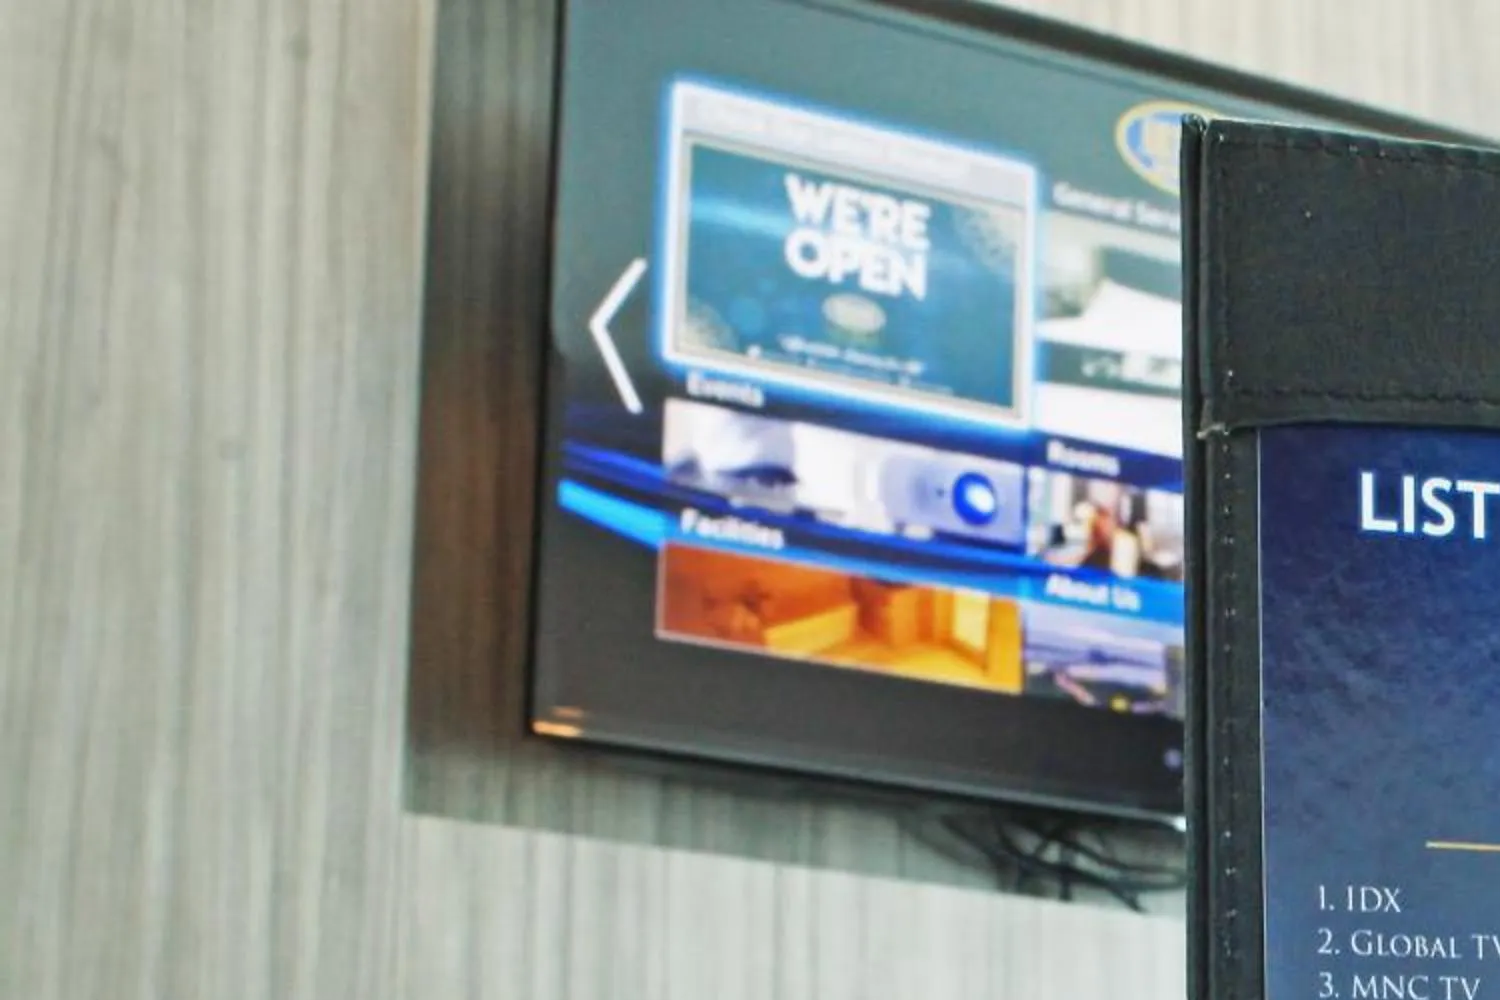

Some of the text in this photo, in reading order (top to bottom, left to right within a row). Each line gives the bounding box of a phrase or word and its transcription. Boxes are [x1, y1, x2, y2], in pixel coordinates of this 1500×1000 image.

[785, 227, 927, 300] OPEN
[1360, 470, 1500, 540] LIST
[1318, 884, 1402, 913] 1. IDX
[1316, 929, 1340, 956] 2.
[1350, 930, 1462, 960] GLOBAL
[1317, 972, 1340, 999] 3.
[1350, 975, 1429, 1000] MNC
